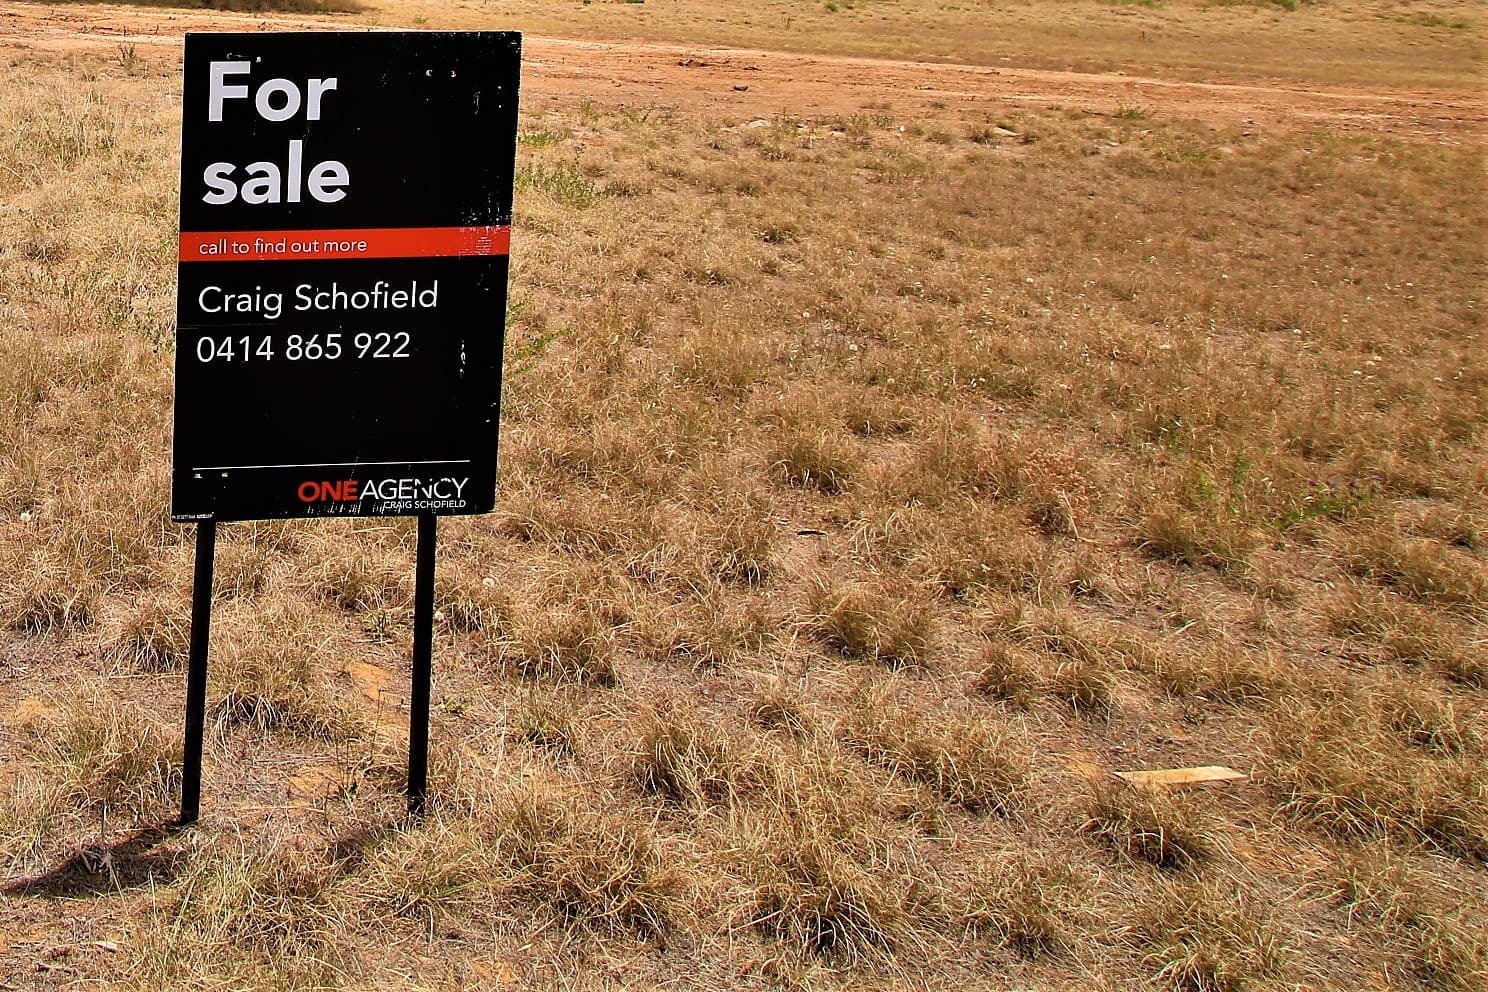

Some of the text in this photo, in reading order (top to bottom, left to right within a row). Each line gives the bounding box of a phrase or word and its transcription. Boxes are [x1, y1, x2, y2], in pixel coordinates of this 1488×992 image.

[208, 61, 338, 122] For
[201, 139, 350, 205] sale
[198, 237, 368, 255] call to find out more
[198, 279, 439, 320] Craig Schofield
[196, 331, 410, 363] 0414 865 922
[383, 499, 467, 510] CRAIG SCHOFIELD
